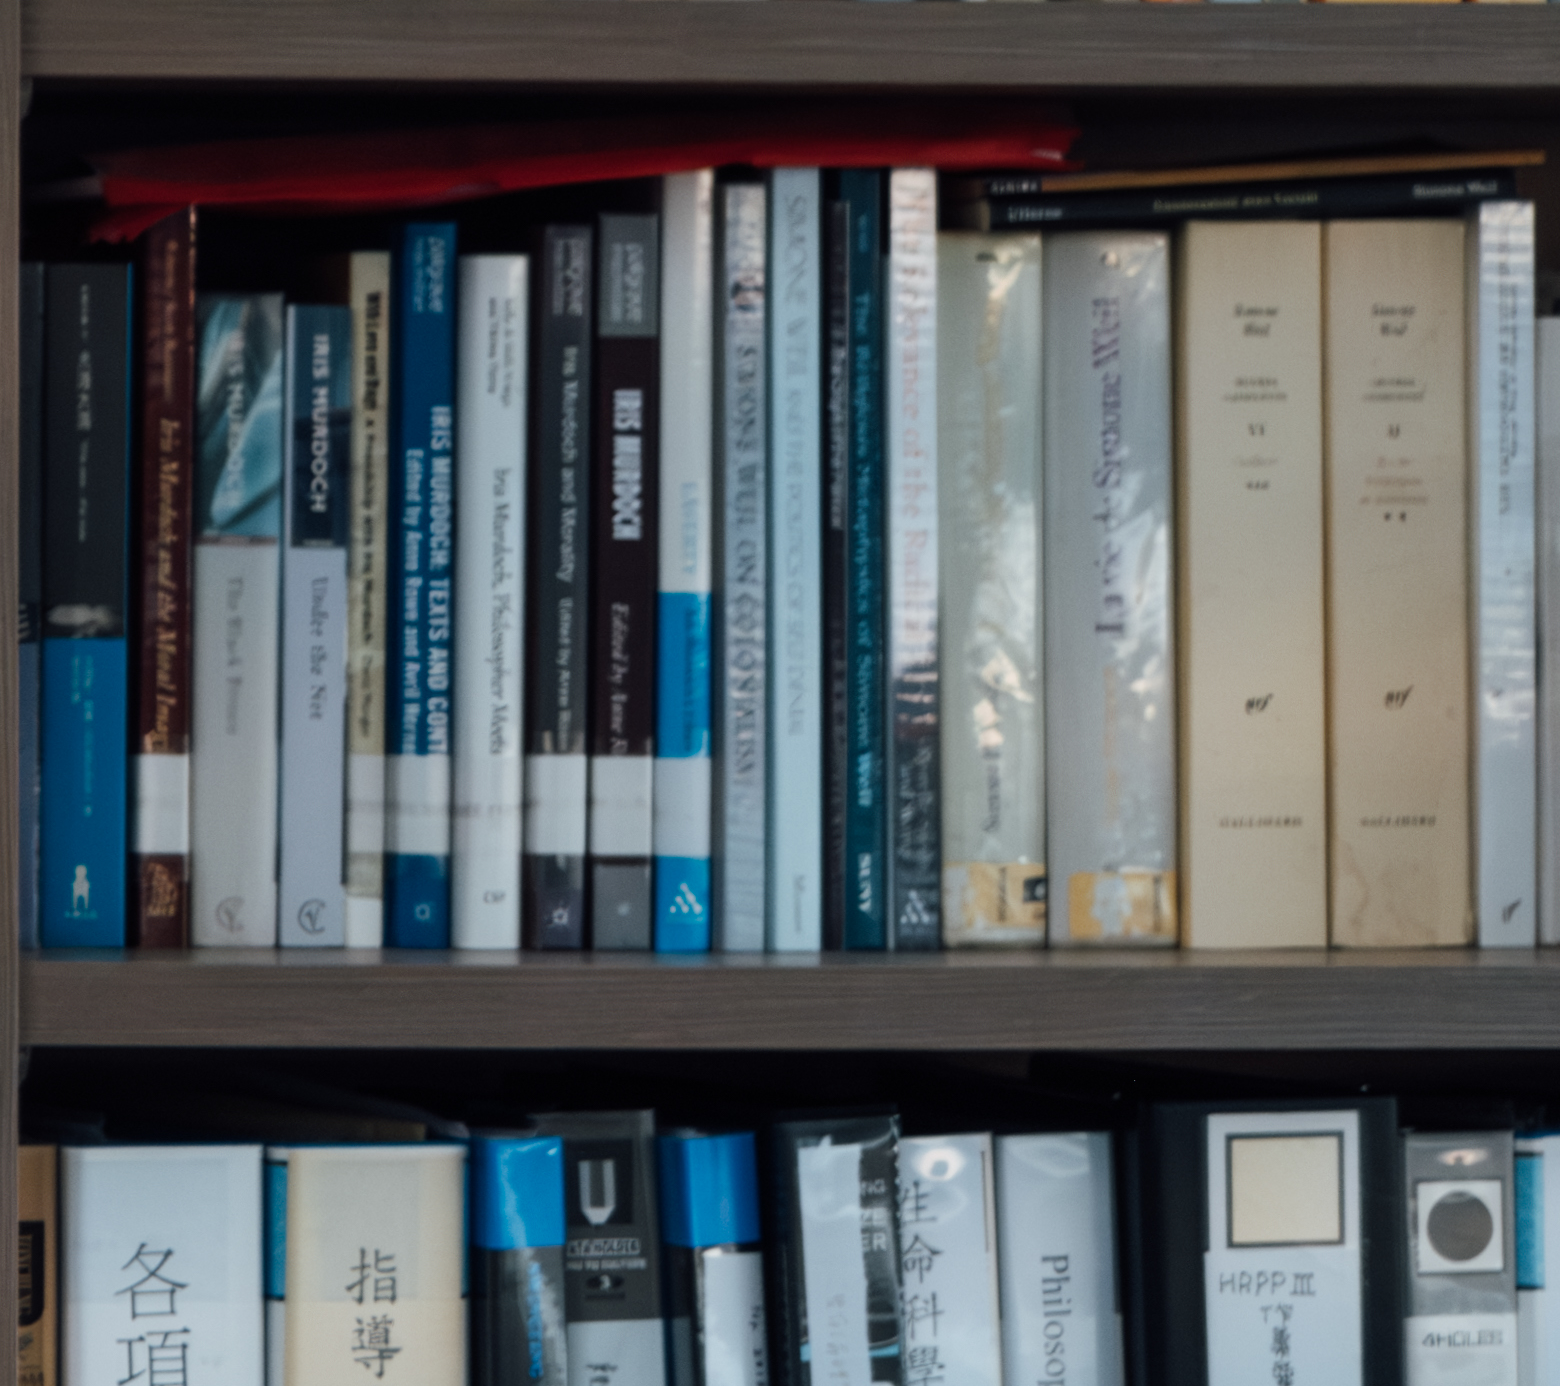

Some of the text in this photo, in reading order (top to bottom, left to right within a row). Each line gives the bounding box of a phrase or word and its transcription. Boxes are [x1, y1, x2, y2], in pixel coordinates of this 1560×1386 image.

[310, 333, 330, 513] IRIS MURDOCH
[555, 380, 579, 583] Murdoch and Morality
[613, 389, 643, 540] IRIS MURDOCH
[1090, 298, 1123, 489] Simone Weil
[156, 418, 179, 690] Iris Murdoch and the Moral
[403, 448, 424, 699] Edited by Anne and Avril
[428, 405, 451, 692] IRIS TEXTS AND
[854, 292, 873, 746] The of Simone
[309, 644, 329, 677] the
[608, 666, 629, 685] by
[610, 602, 629, 663] Edited
[1219, 1270, 1286, 1297] HRPP
